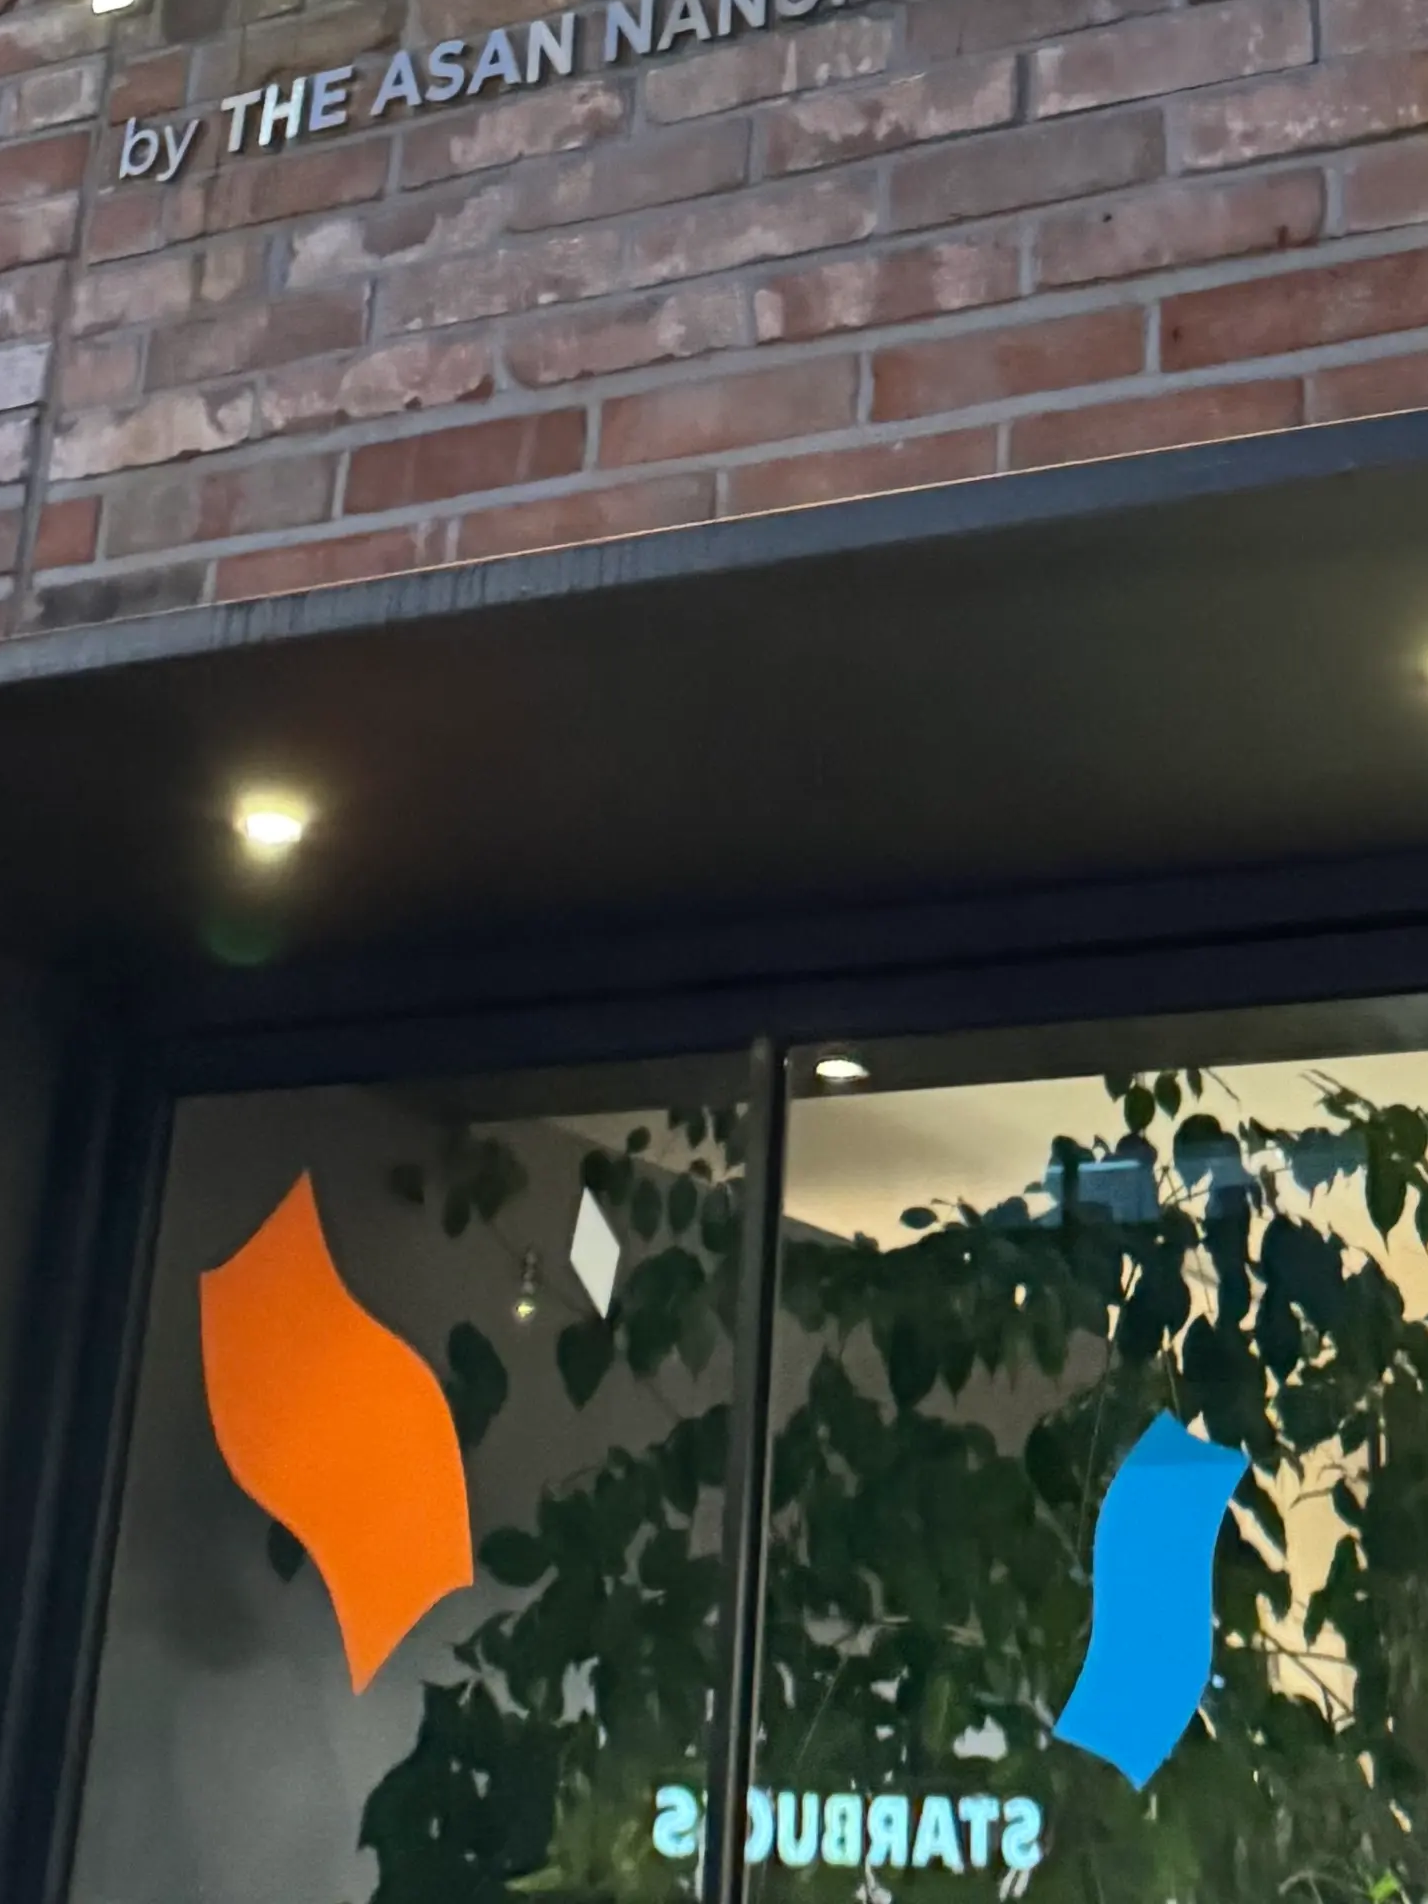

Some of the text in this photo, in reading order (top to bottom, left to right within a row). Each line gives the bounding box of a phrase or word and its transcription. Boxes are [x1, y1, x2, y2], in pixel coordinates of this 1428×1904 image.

[118, 116, 200, 183] by
[220, 64, 355, 154] THE
[370, 12, 576, 118] ASAN
